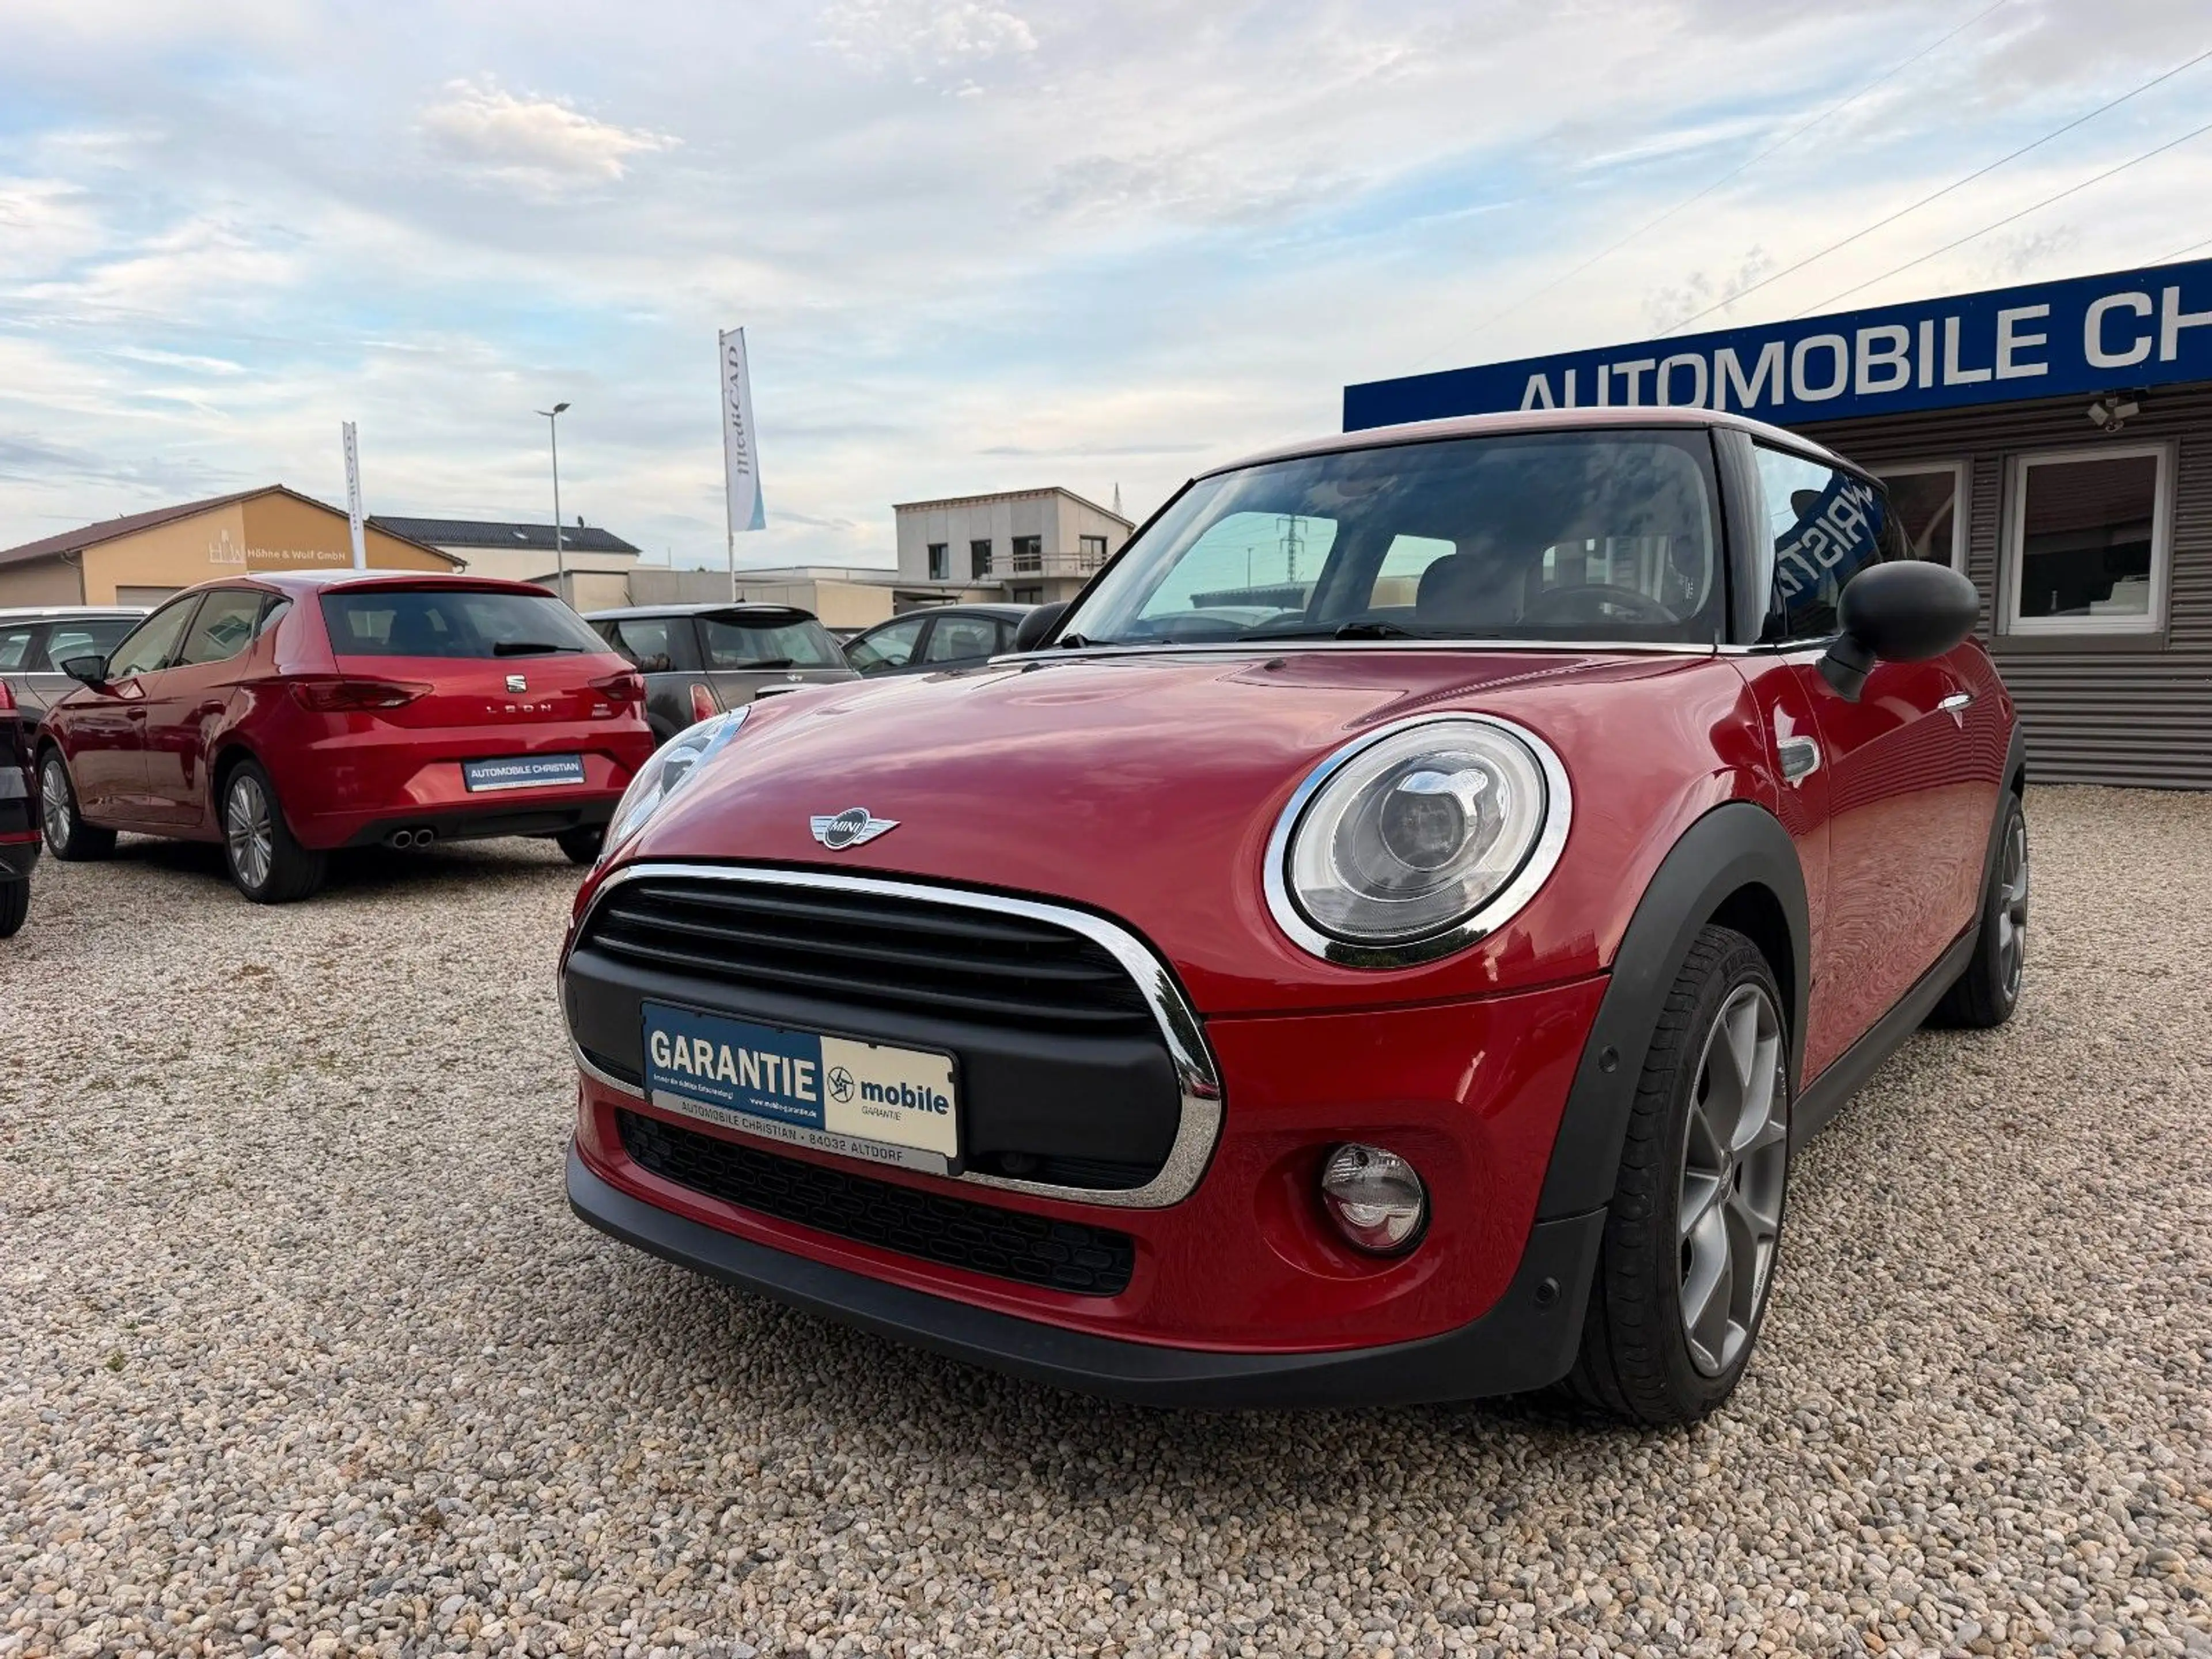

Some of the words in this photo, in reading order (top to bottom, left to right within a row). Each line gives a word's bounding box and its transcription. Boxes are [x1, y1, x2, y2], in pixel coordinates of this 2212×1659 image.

[1520, 303, 2050, 411] AUTOMOBILE
[2084, 286, 2212, 368] CH
[282, 550, 290, 559] &
[317, 551, 346, 562] GmbH
[486, 703, 552, 713] LEON
[471, 765, 532, 778] AUTOMOBILE
[532, 762, 579, 774] CHRISTIAN
[830, 821, 862, 833] MINI
[650, 1029, 817, 1102] GARANTIE
[860, 1080, 950, 1116] mobile
[861, 1105, 903, 1121] GARANTIE
[682, 1101, 740, 1127] AUTOMOBILE
[742, 1118, 797, 1140] CHRISTIAN
[809, 1134, 847, 1151] 84032
[851, 1142, 905, 1162] ALTDORF
